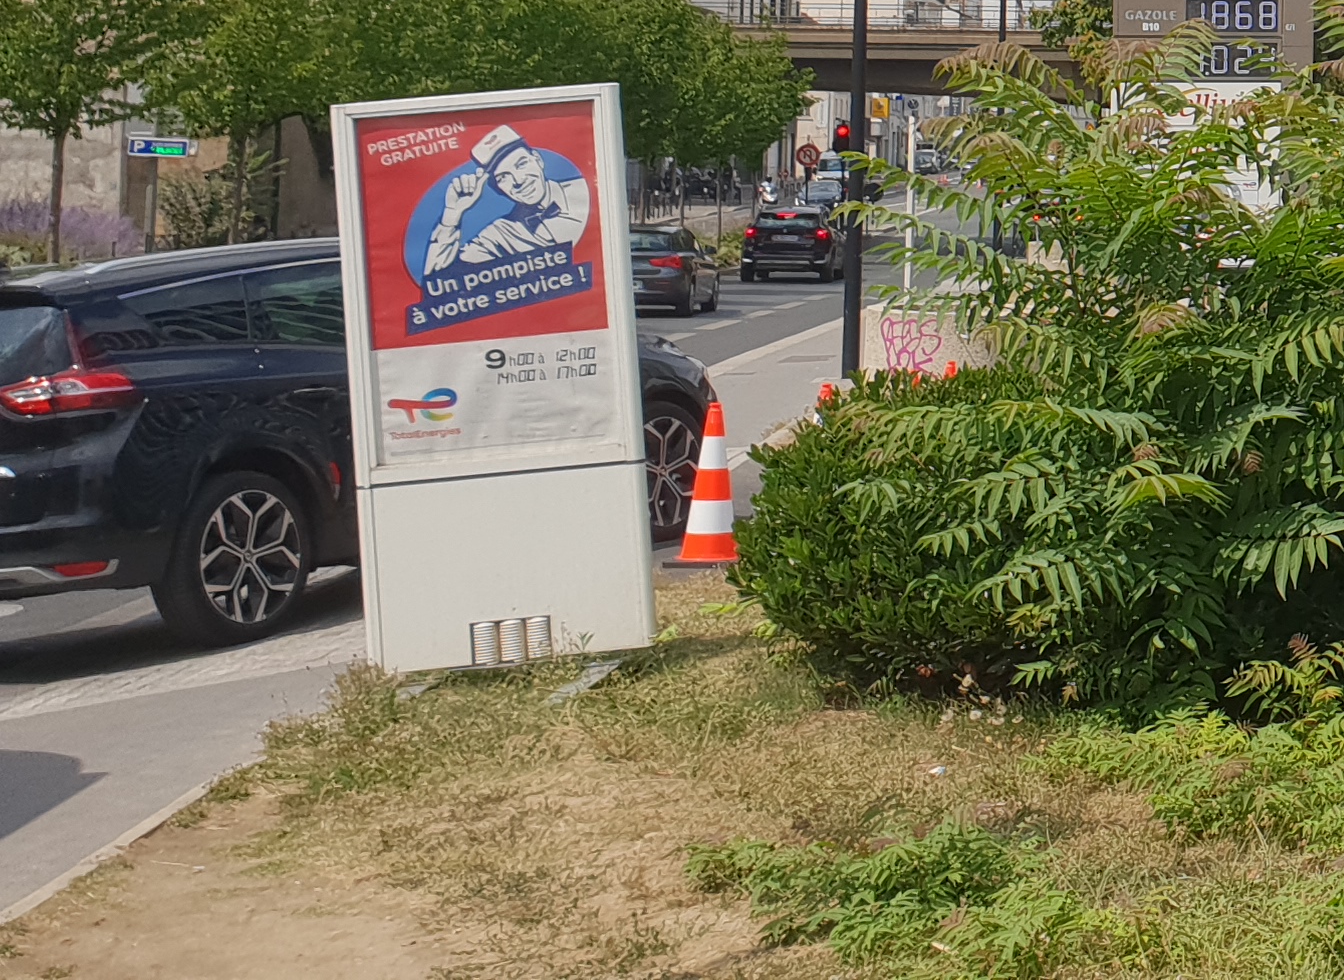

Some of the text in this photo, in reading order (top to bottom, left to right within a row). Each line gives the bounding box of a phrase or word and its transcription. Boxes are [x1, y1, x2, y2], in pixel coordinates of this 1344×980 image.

[1125, 9, 1178, 21] GAZOLE
[1141, 22, 1160, 32] B10
[367, 121, 466, 155] PRESTATION
[380, 137, 459, 166] GRATUITE
[426, 250, 568, 297] Un pompiste
[412, 306, 426, 325] à
[430, 294, 490, 320] votre
[494, 271, 574, 304] service
[555, 346, 597, 362] 12h00
[556, 363, 597, 380] 17h00
